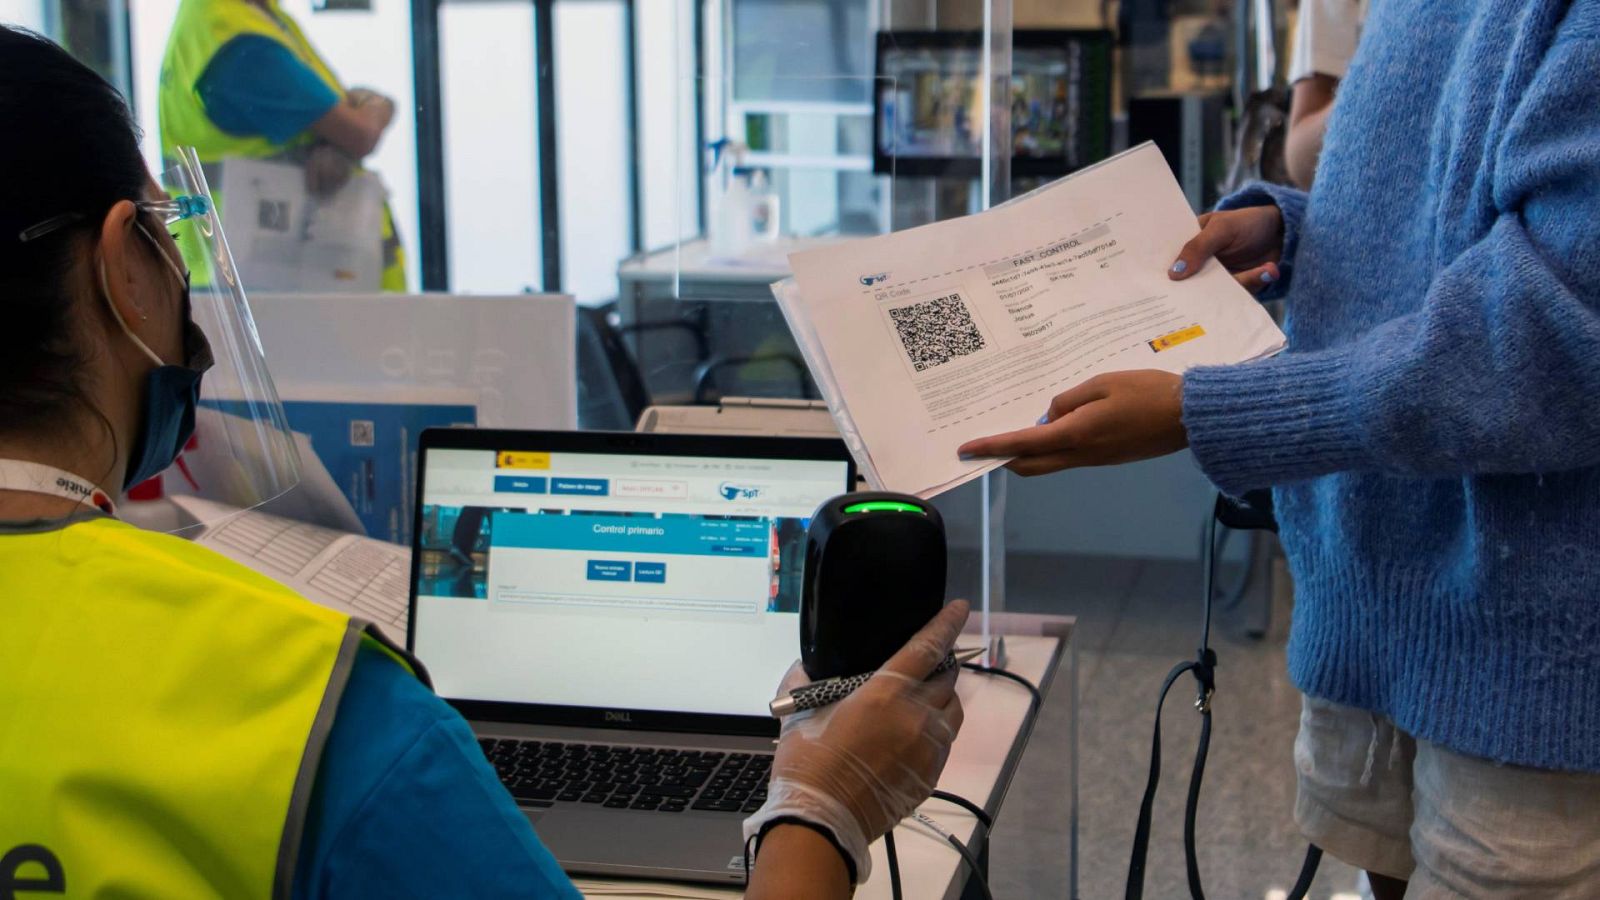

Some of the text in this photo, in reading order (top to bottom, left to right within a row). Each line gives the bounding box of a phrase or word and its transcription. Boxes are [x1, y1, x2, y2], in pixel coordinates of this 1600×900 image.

[1012, 255, 1035, 267] FAST
[1039, 239, 1081, 258] CONTROL
[875, 287, 911, 301] QR Code
[56, 477, 92, 496] mitie
[593, 523, 665, 538] Control primario
[605, 711, 632, 722] DELL
